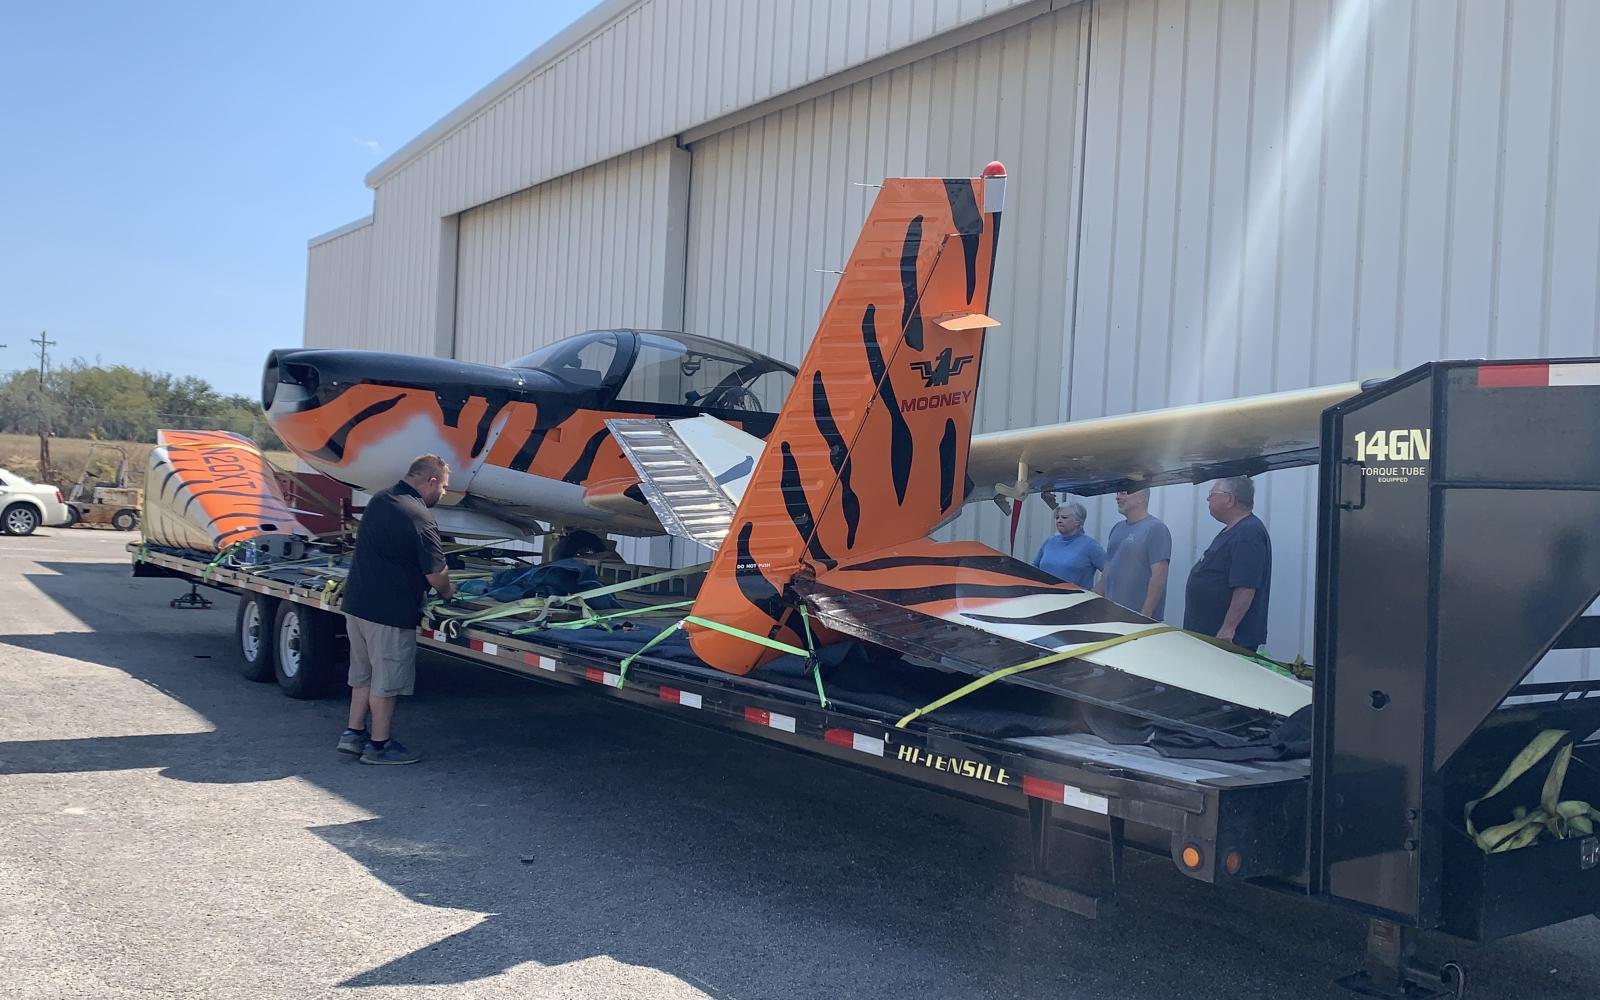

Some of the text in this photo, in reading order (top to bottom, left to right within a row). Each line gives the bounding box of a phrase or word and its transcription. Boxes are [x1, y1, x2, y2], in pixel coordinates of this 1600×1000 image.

[901, 390, 972, 413] MOONEY
[1354, 428, 1431, 462] 14GN
[200, 447, 257, 489] N20XT
[1360, 466, 1426, 476] TORQUE TUBE
[897, 744, 1010, 786] HI-TENSILE
